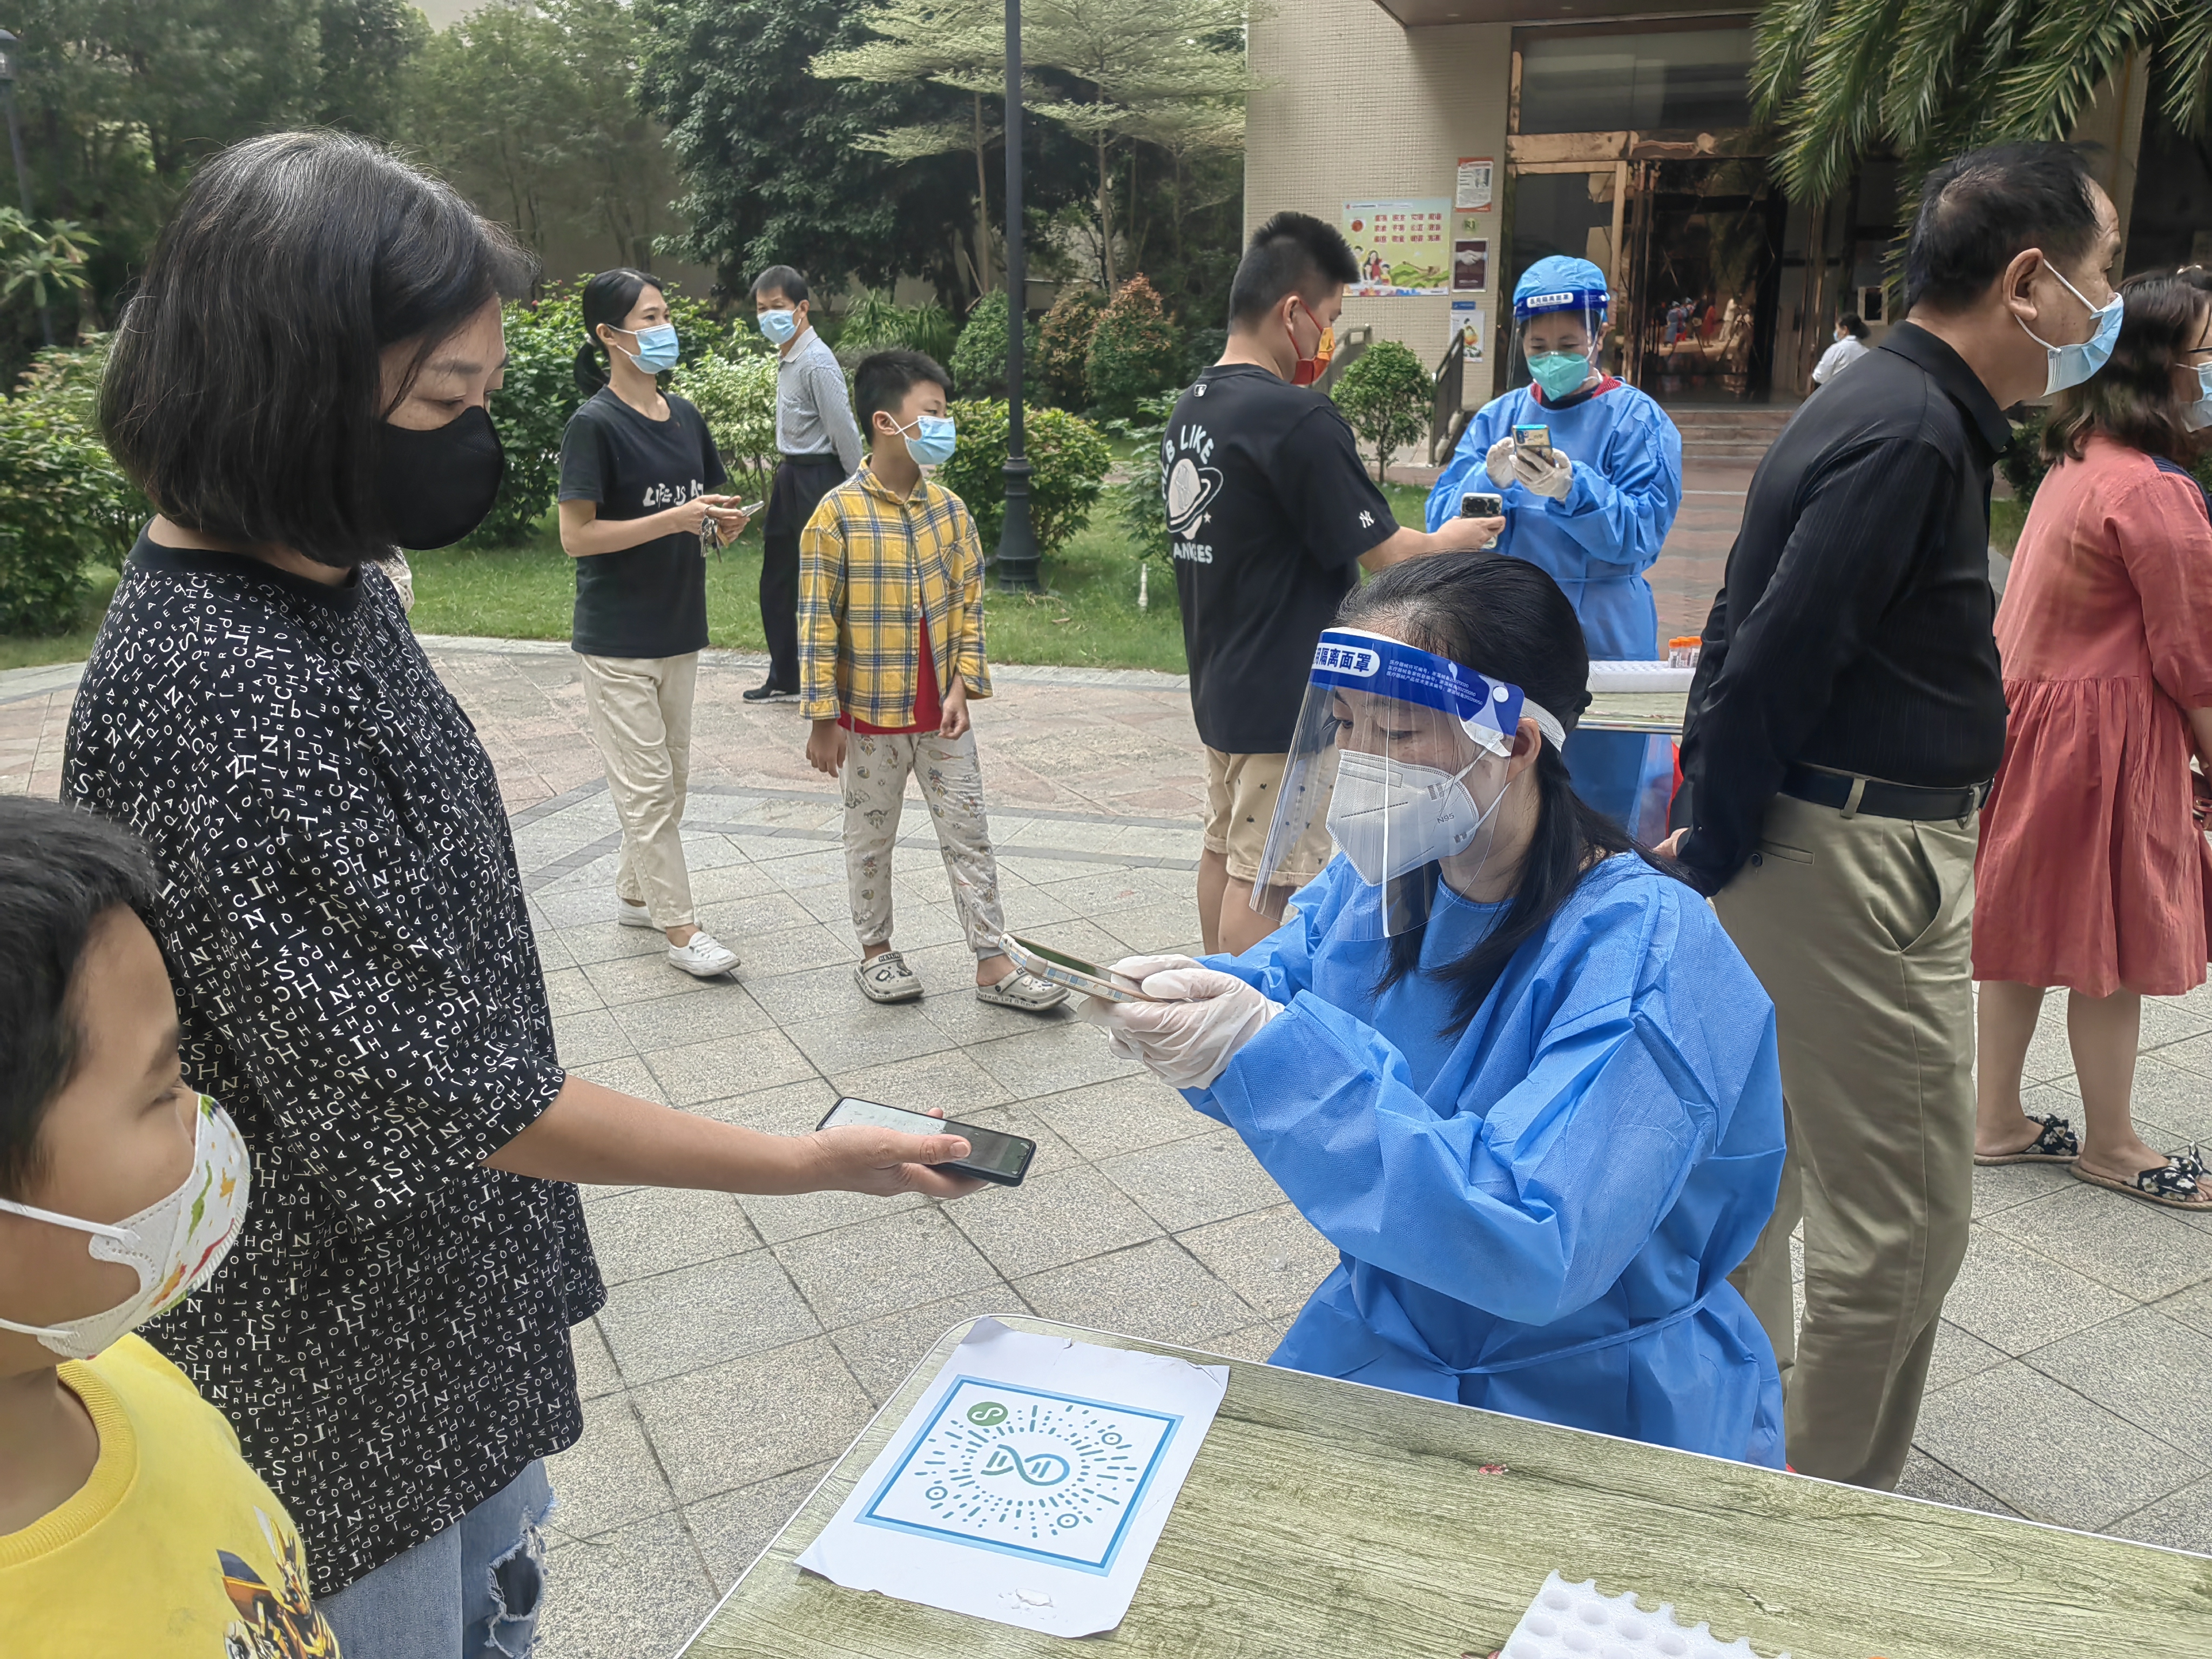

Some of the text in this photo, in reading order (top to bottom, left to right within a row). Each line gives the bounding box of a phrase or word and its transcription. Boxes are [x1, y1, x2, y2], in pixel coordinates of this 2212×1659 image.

[1180, 424, 1214, 464] LIKE
[643, 483, 673, 508] LIFE
[1437, 812, 1455, 824] N95
